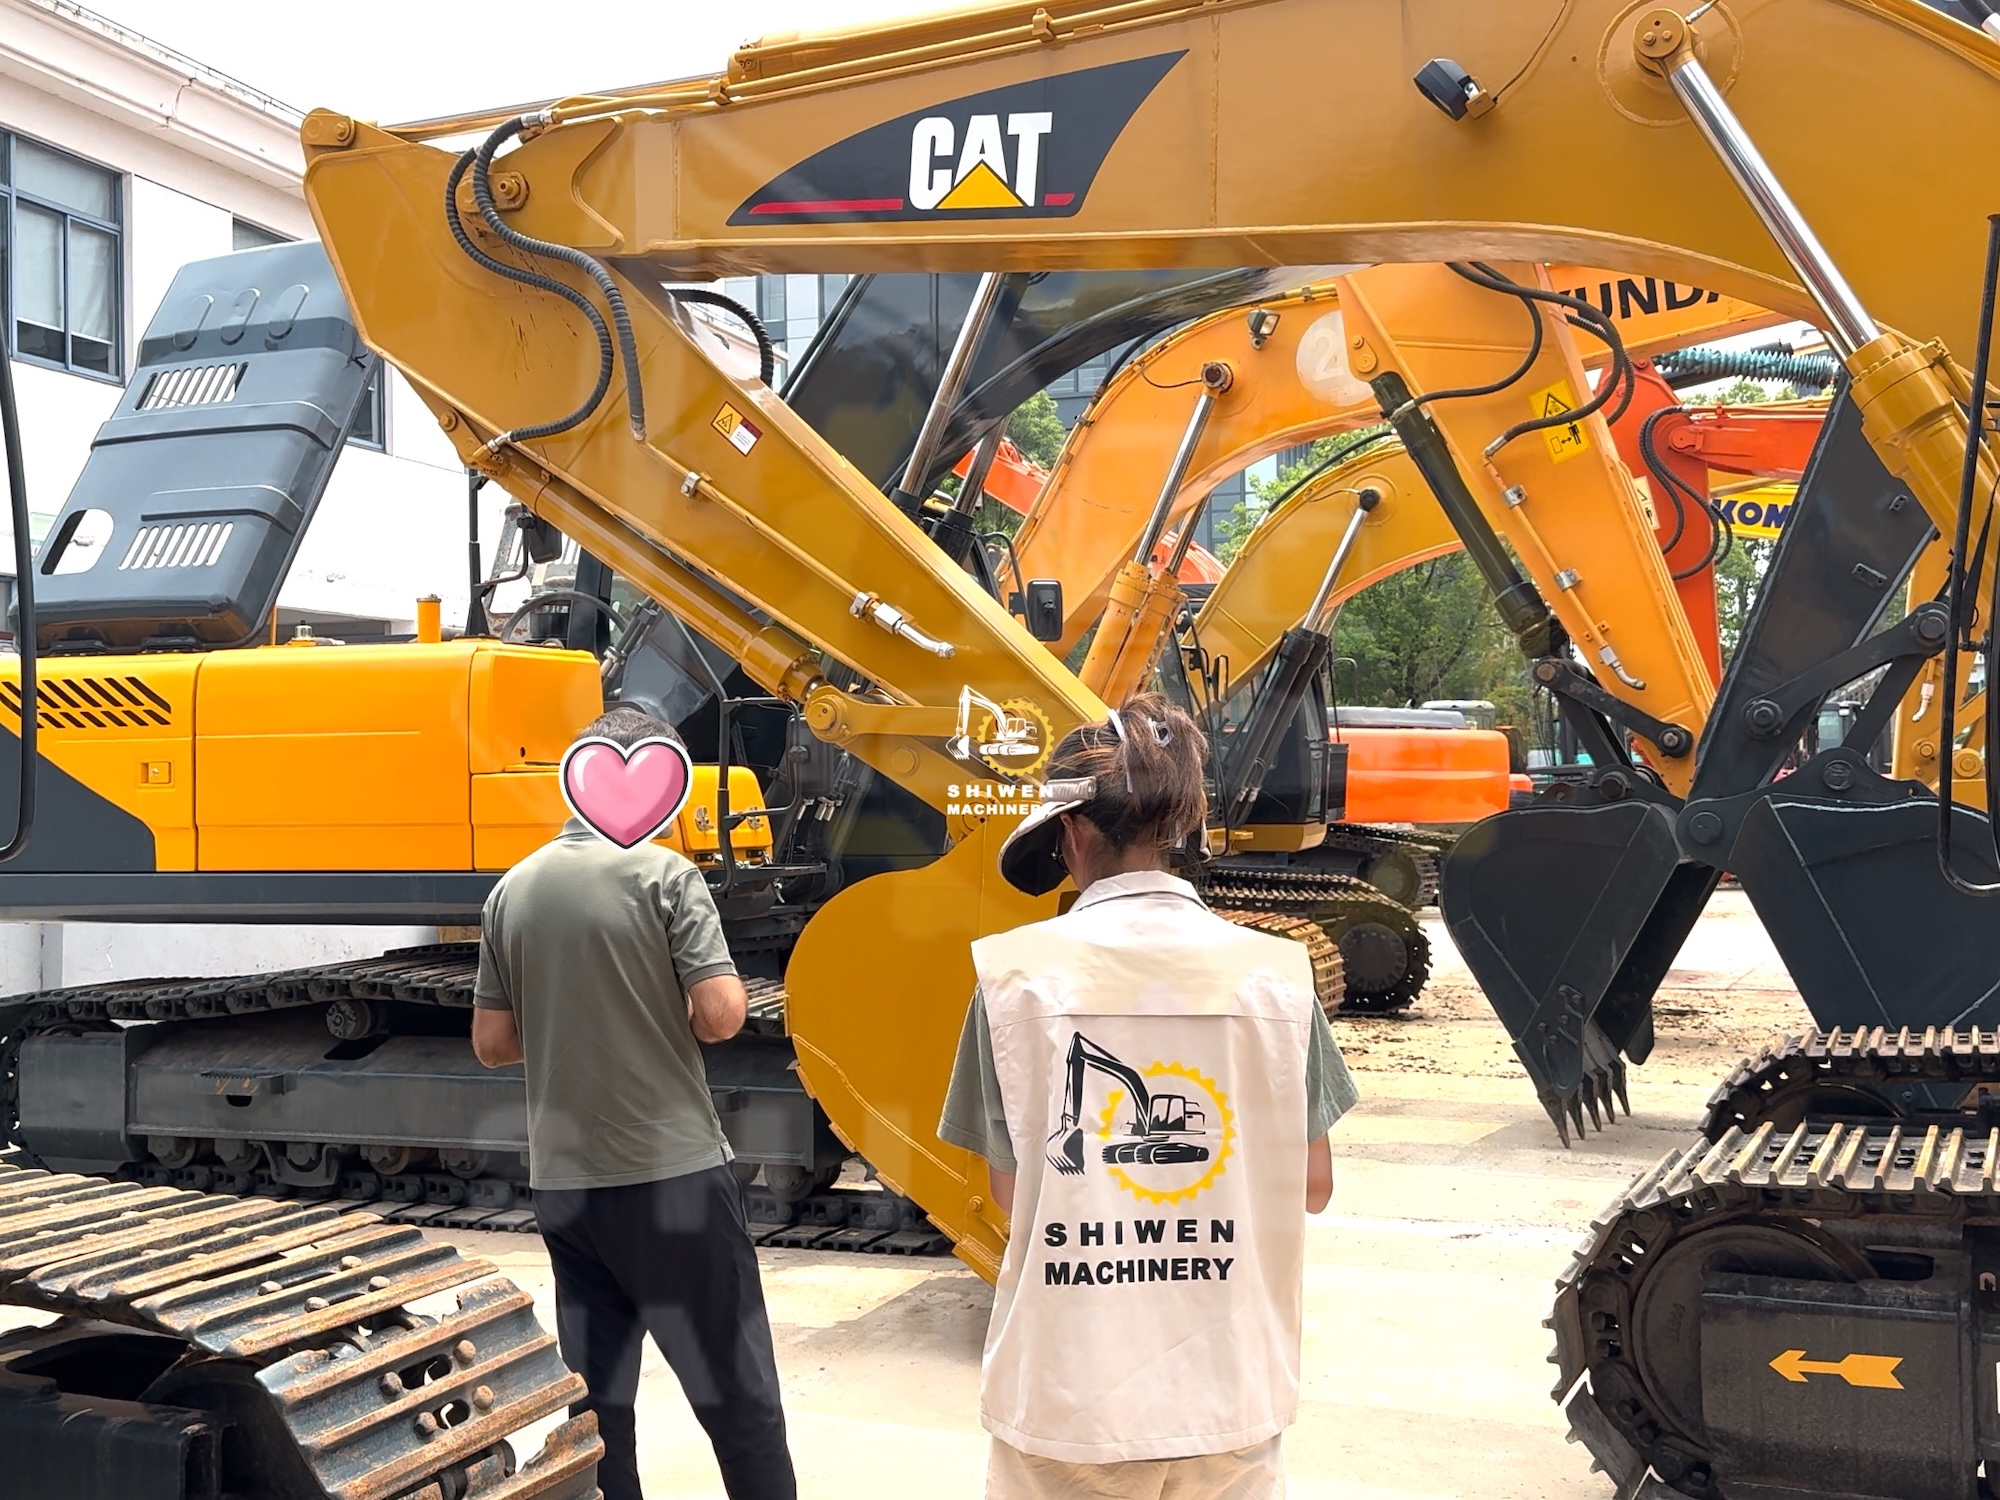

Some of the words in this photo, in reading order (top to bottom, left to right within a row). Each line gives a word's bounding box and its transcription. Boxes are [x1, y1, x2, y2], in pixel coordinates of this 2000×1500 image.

[909, 112, 1053, 210] CAT
[1044, 1219, 1234, 1247] SHIWEN
[1045, 1258, 1234, 1286] MACHINERY
